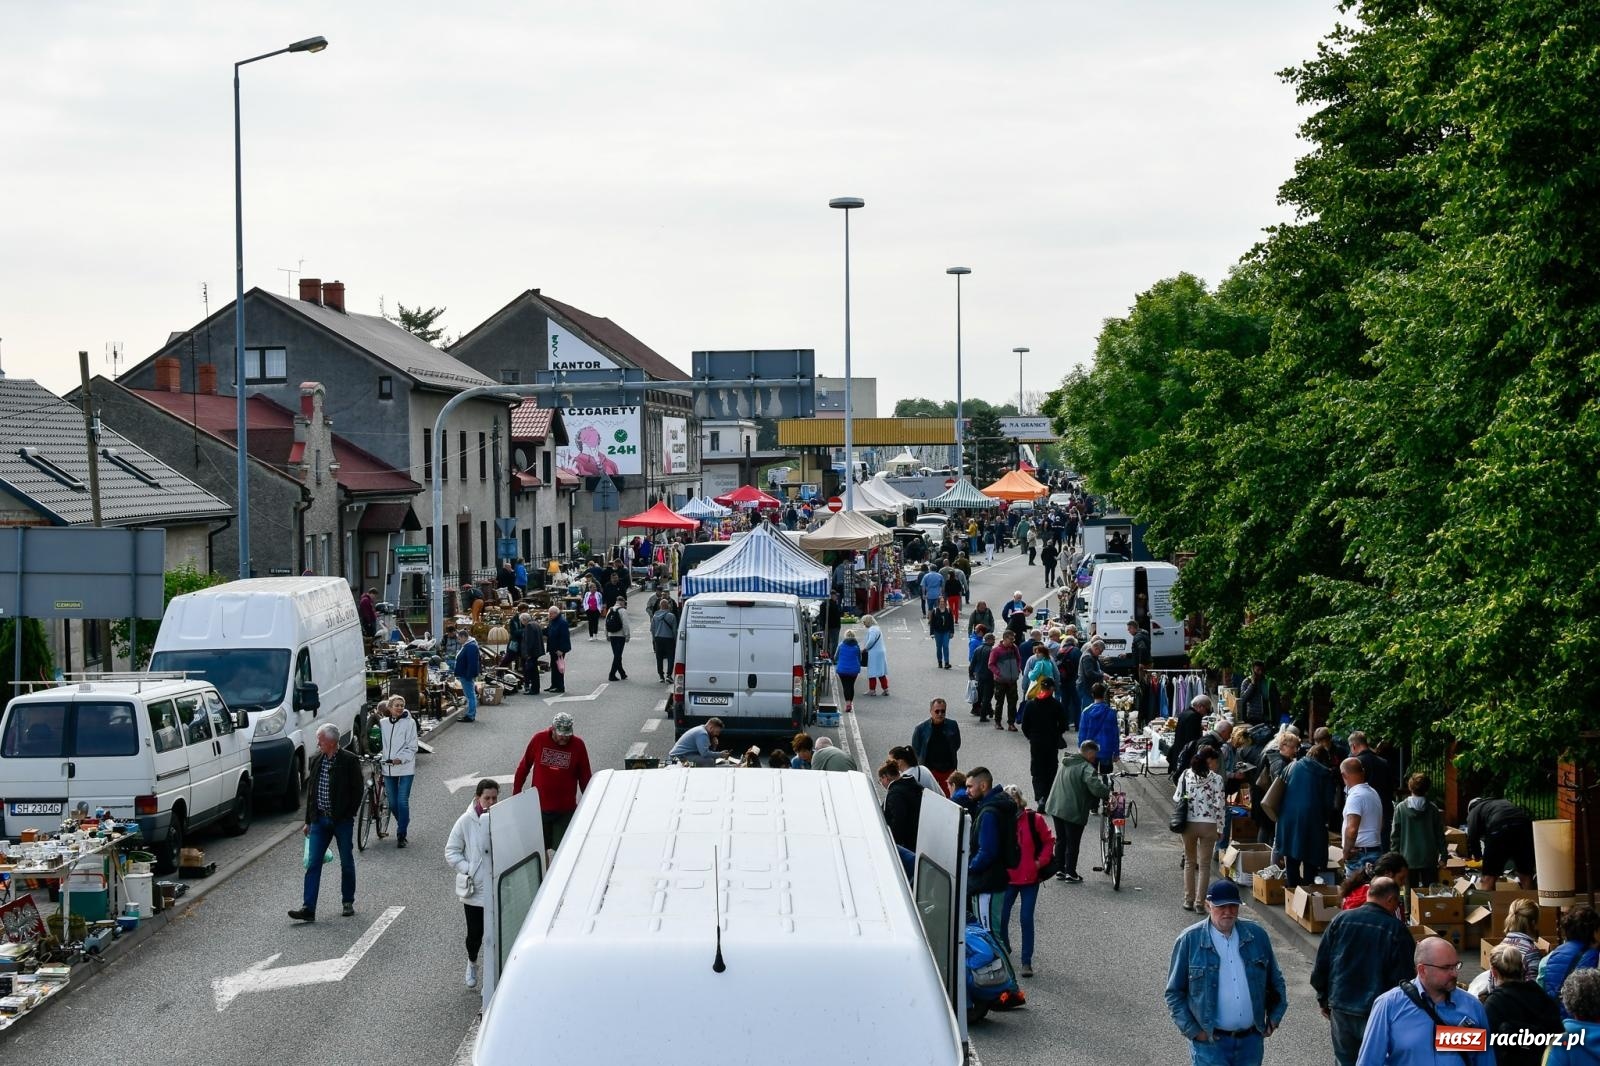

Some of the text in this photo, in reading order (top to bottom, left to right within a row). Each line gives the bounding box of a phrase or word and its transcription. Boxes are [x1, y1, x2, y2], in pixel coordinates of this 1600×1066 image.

[553, 361, 601, 369] KANTOR
[569, 407, 637, 416] CIGARETY
[607, 445, 637, 455] 24H
[17, 804, 60, 813] SH 2304G
